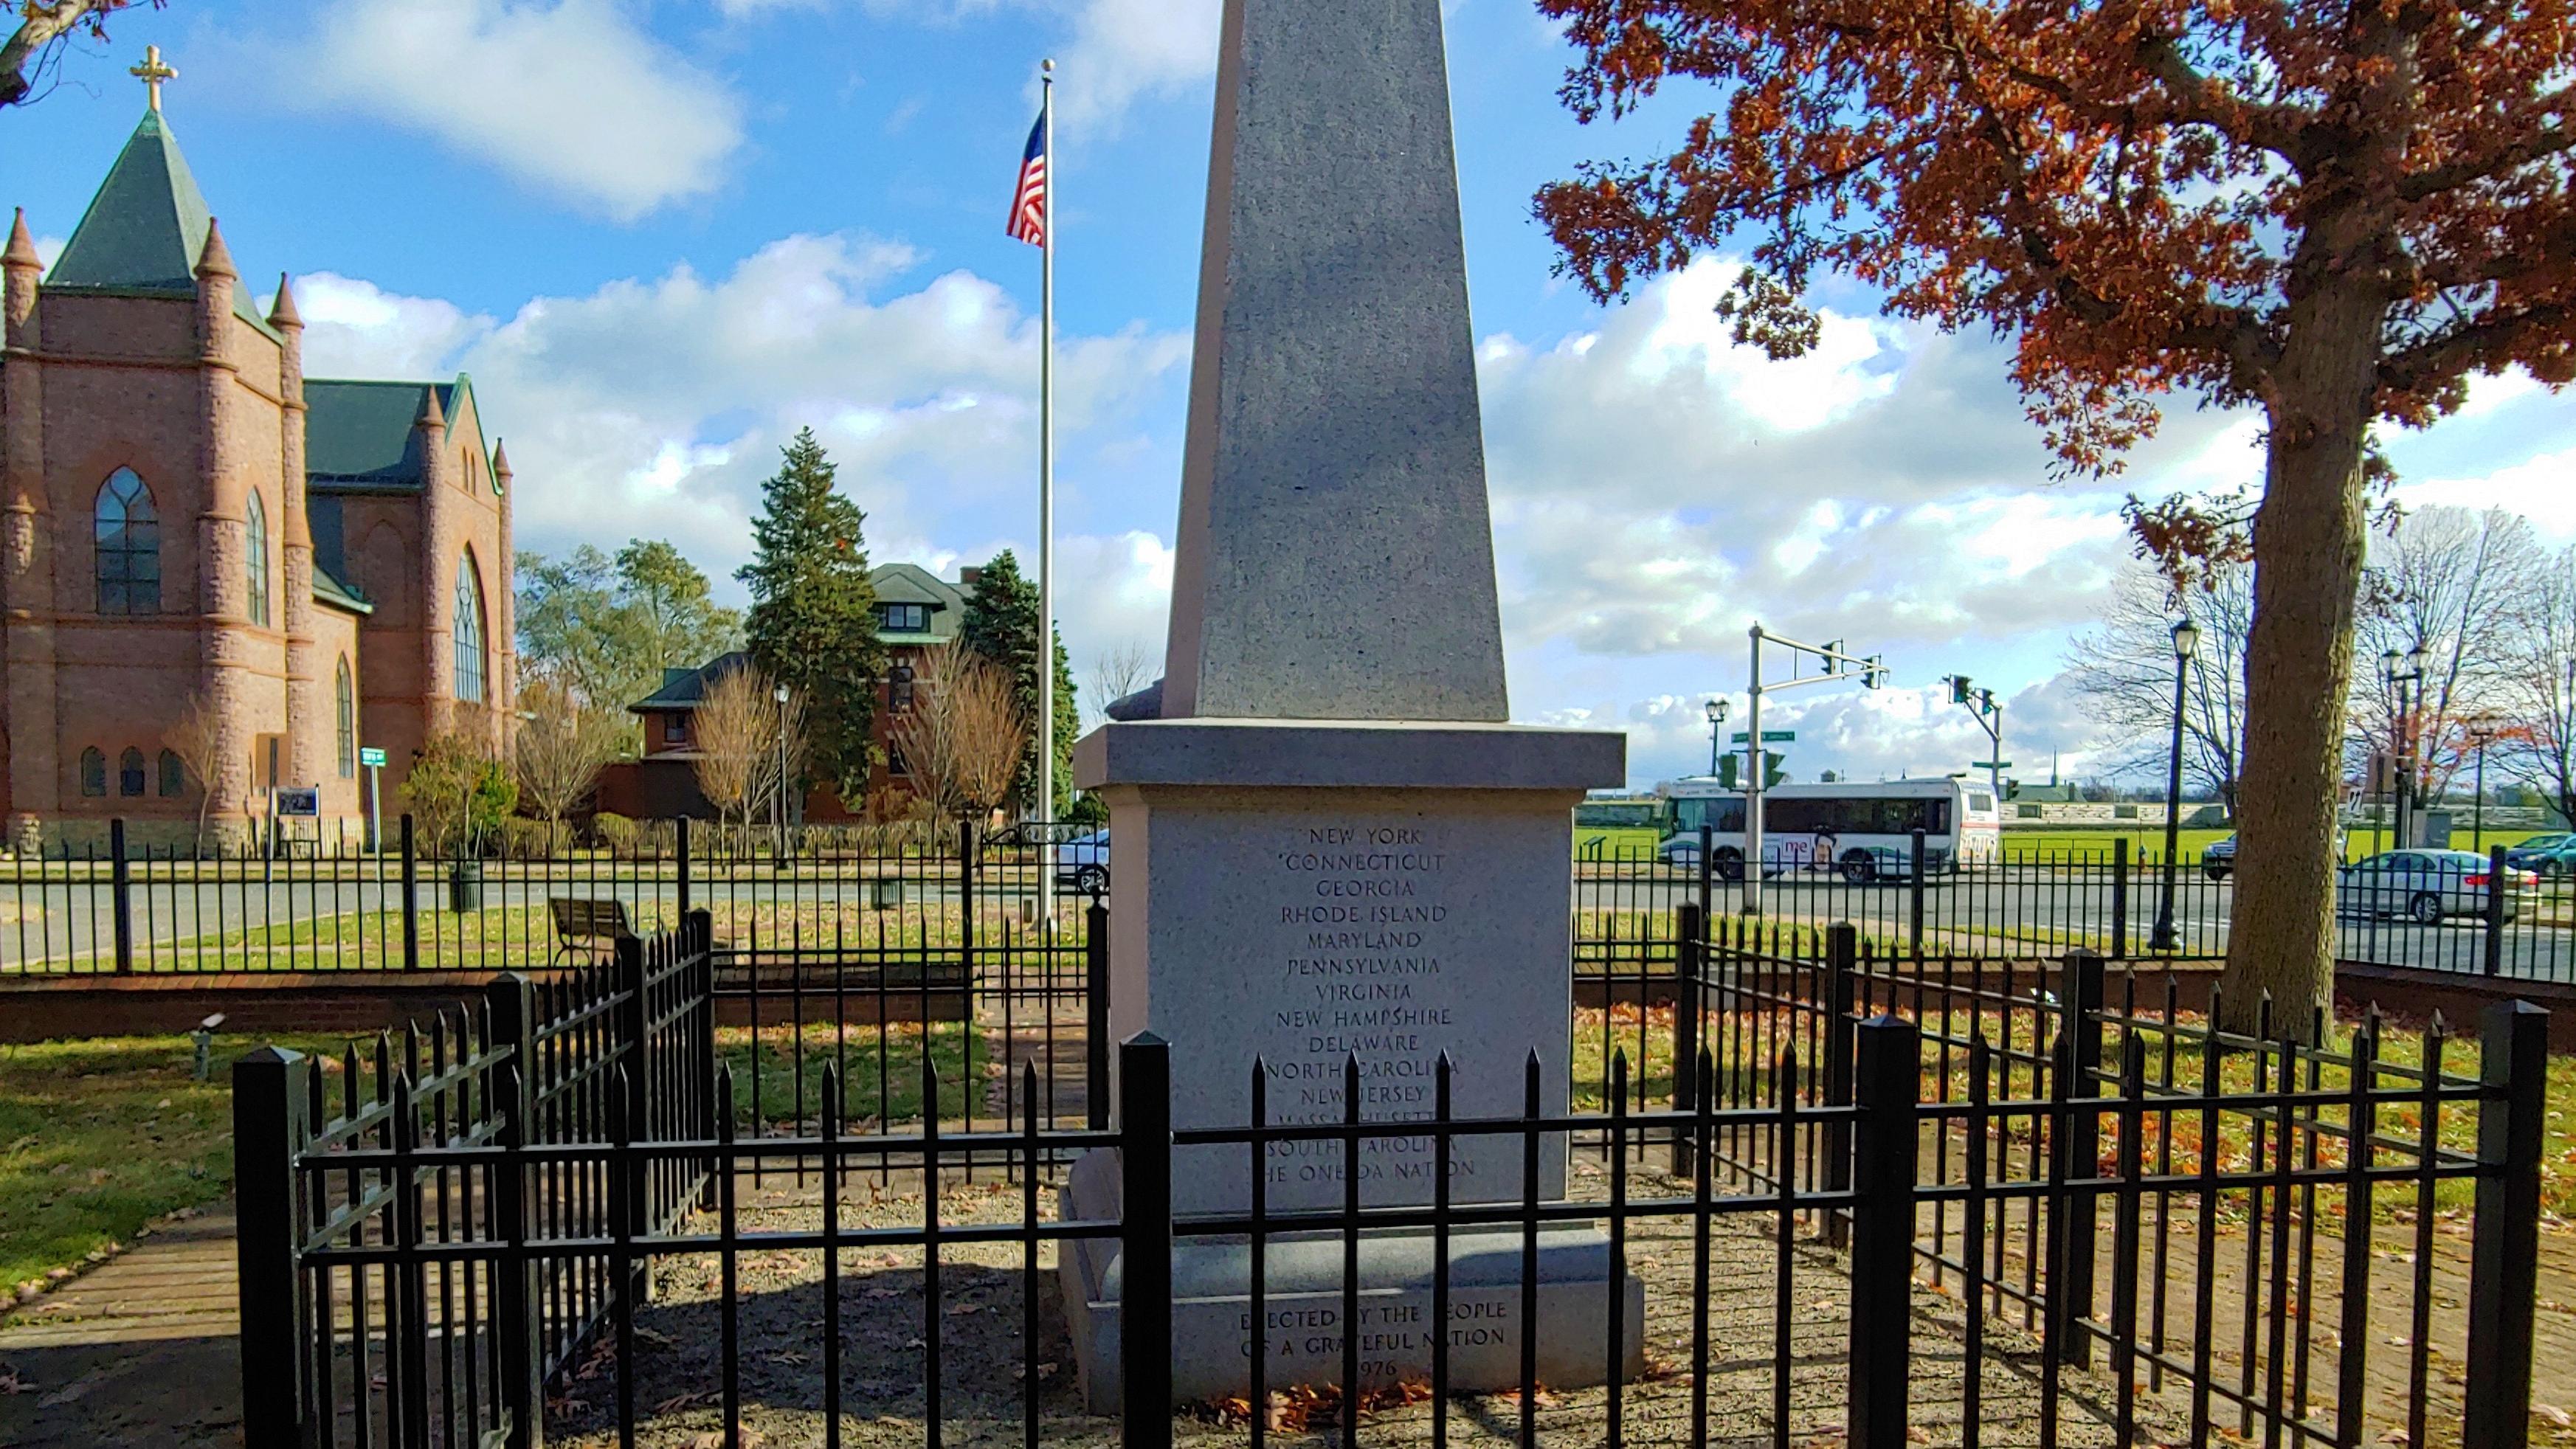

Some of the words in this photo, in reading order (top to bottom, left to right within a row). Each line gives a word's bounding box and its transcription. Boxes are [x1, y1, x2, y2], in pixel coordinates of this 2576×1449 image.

[1310, 828, 1354, 845] NEW
[1367, 828, 1421, 844] YORK
[1286, 853, 1446, 871] CONNECTICUT
[1316, 879, 1414, 897] GEORGIA
[1282, 906, 1359, 924] RHODE
[1371, 905, 1446, 923] ISLAND
[1308, 932, 1421, 950] MARYLAND
[1288, 958, 1440, 975] PENNSYLVANIA
[1316, 984, 1411, 1001] VIRGINIA
[1277, 1011, 1322, 1028] NEW
[1335, 1008, 1451, 1026] HAMPSHIRE
[1309, 1035, 1419, 1053] DELAWARE
[1266, 1062, 1341, 1079] NORTH
[1358, 1060, 1460, 1077] CAROLIA
[1302, 1089, 1346, 1105] NEW
[1267, 1139, 1339, 1158] SOUTH
[1265, 1165, 1286, 1182] HE
[1299, 1163, 1383, 1181] ONEDA
[1395, 1161, 1474, 1179] NATON
[1240, 1310, 1336, 1329] EECTED
[1381, 1306, 1420, 1323] THE
[1447, 1301, 1507, 1319] EOPLE
[1282, 1340, 1294, 1356] A
[1305, 1332, 1414, 1354] GRAEFUL
[1423, 1329, 1504, 1348] NTION
[1360, 1360, 1398, 1377] 976
